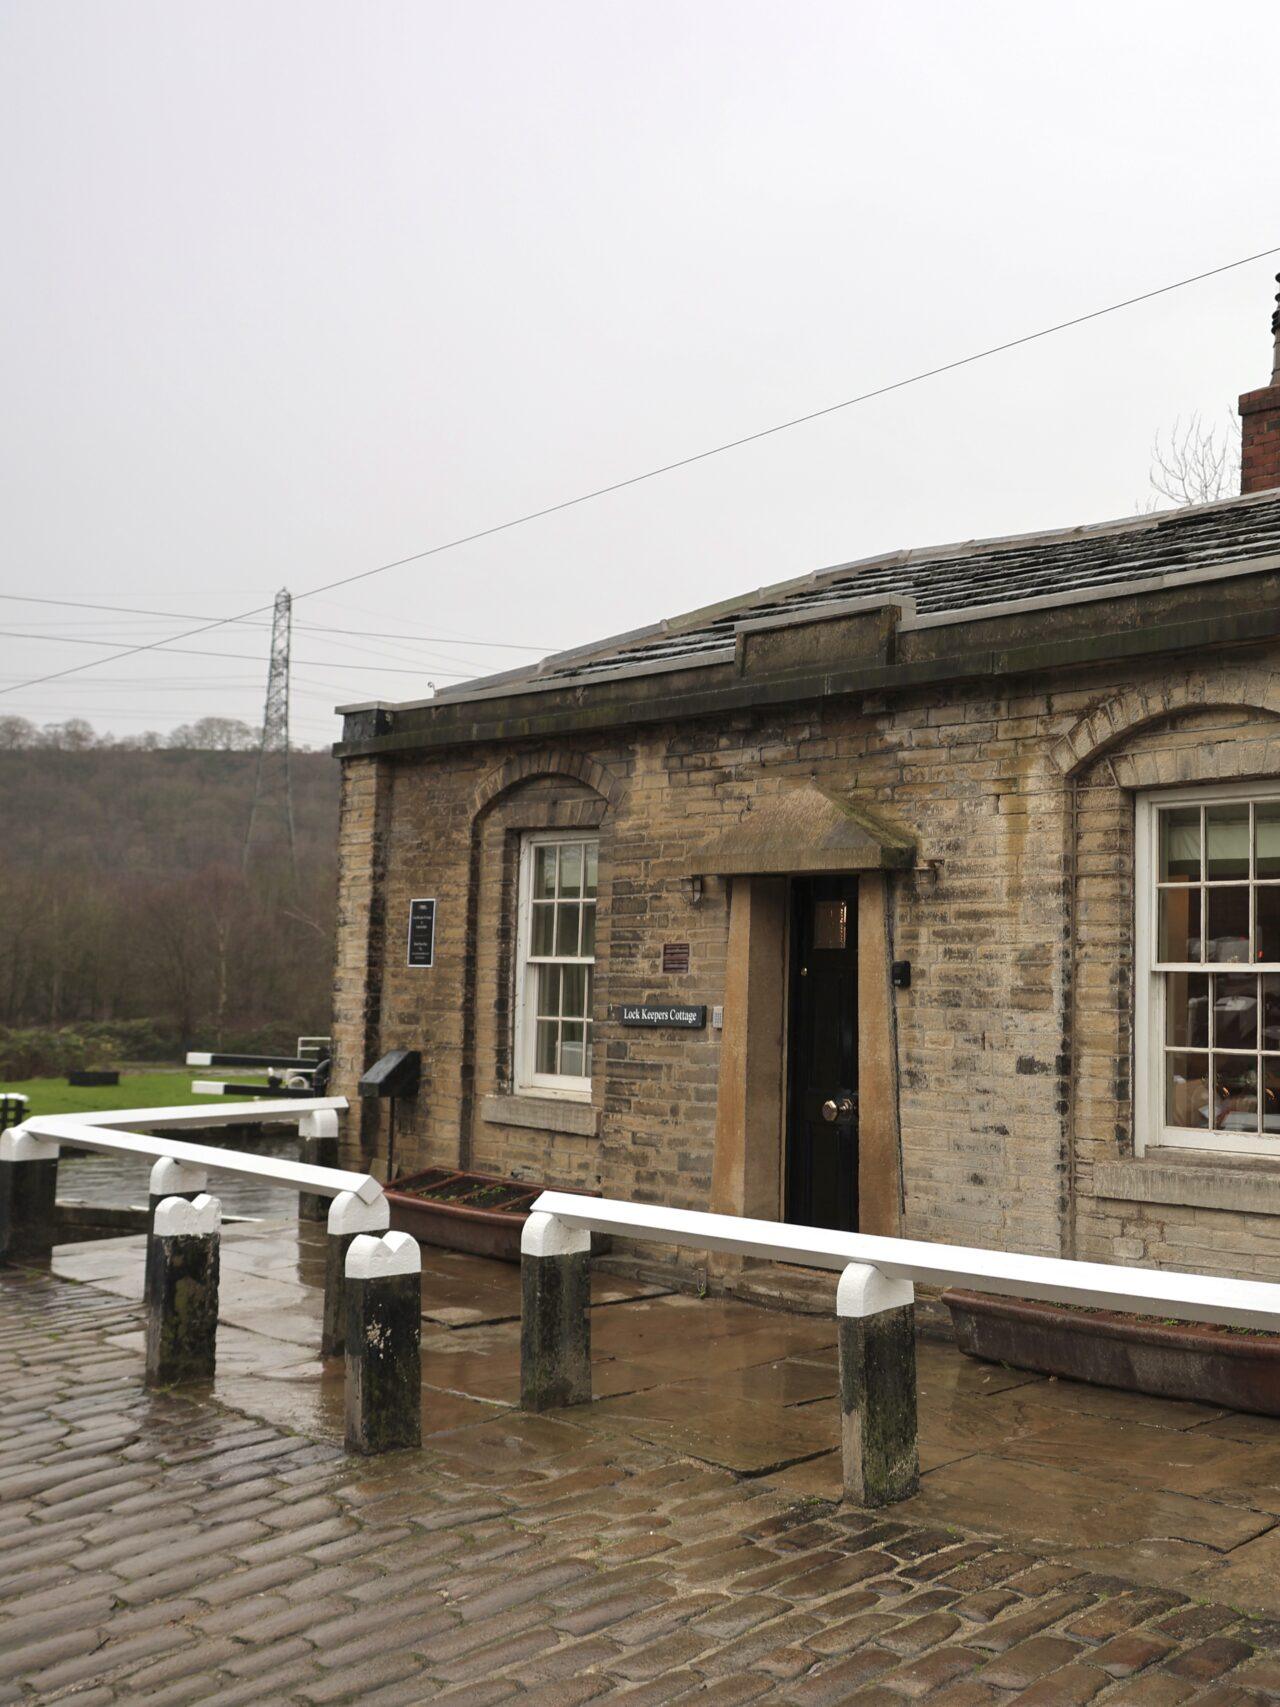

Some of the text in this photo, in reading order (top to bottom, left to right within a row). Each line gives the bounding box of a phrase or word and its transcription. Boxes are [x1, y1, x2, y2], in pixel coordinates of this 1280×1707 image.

[624, 1008, 697, 1023] Lock Keepers Cottage
